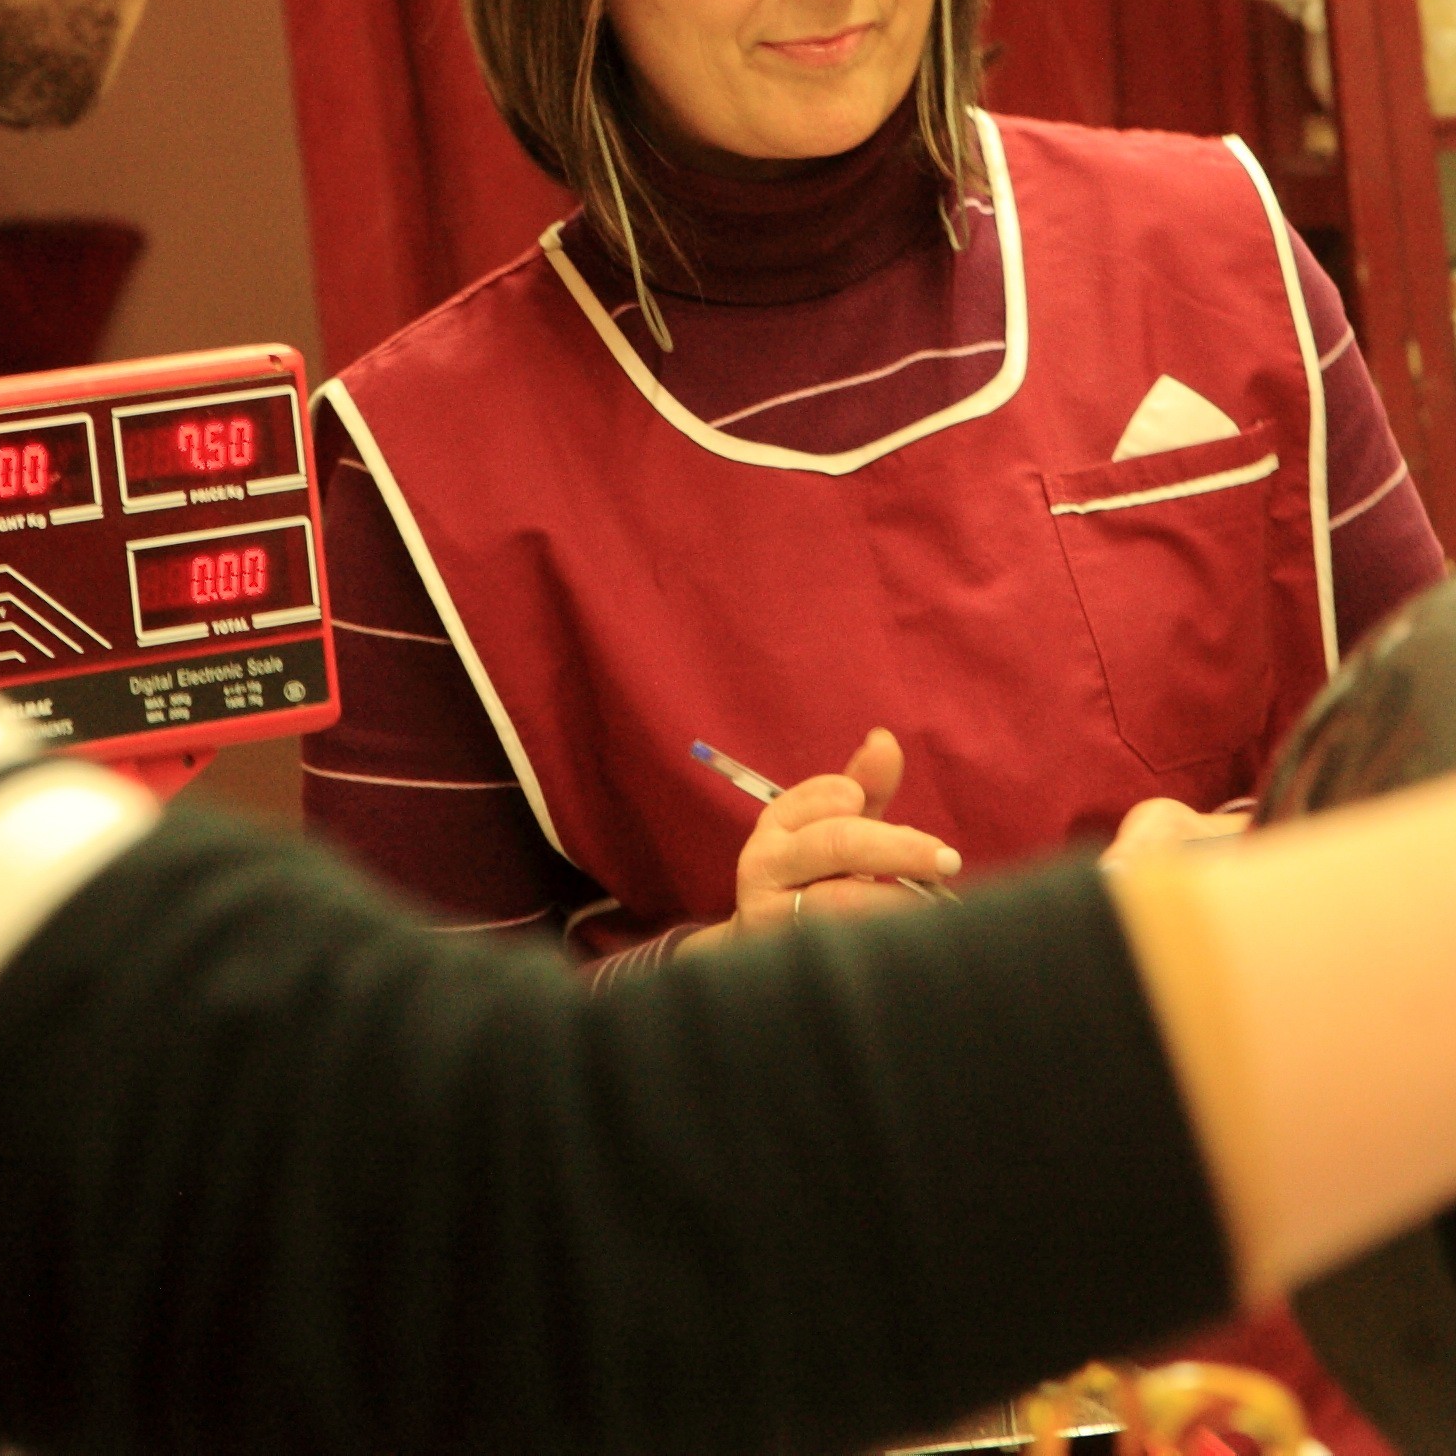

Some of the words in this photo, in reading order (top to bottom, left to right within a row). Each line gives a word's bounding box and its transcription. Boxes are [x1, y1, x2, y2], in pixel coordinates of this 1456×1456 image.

[192, 548, 266, 605] 0.00
[211, 616, 251, 636] TOTAL
[129, 670, 174, 697] Digital
[176, 660, 244, 688] Electronic
[246, 654, 284, 677] Scale
